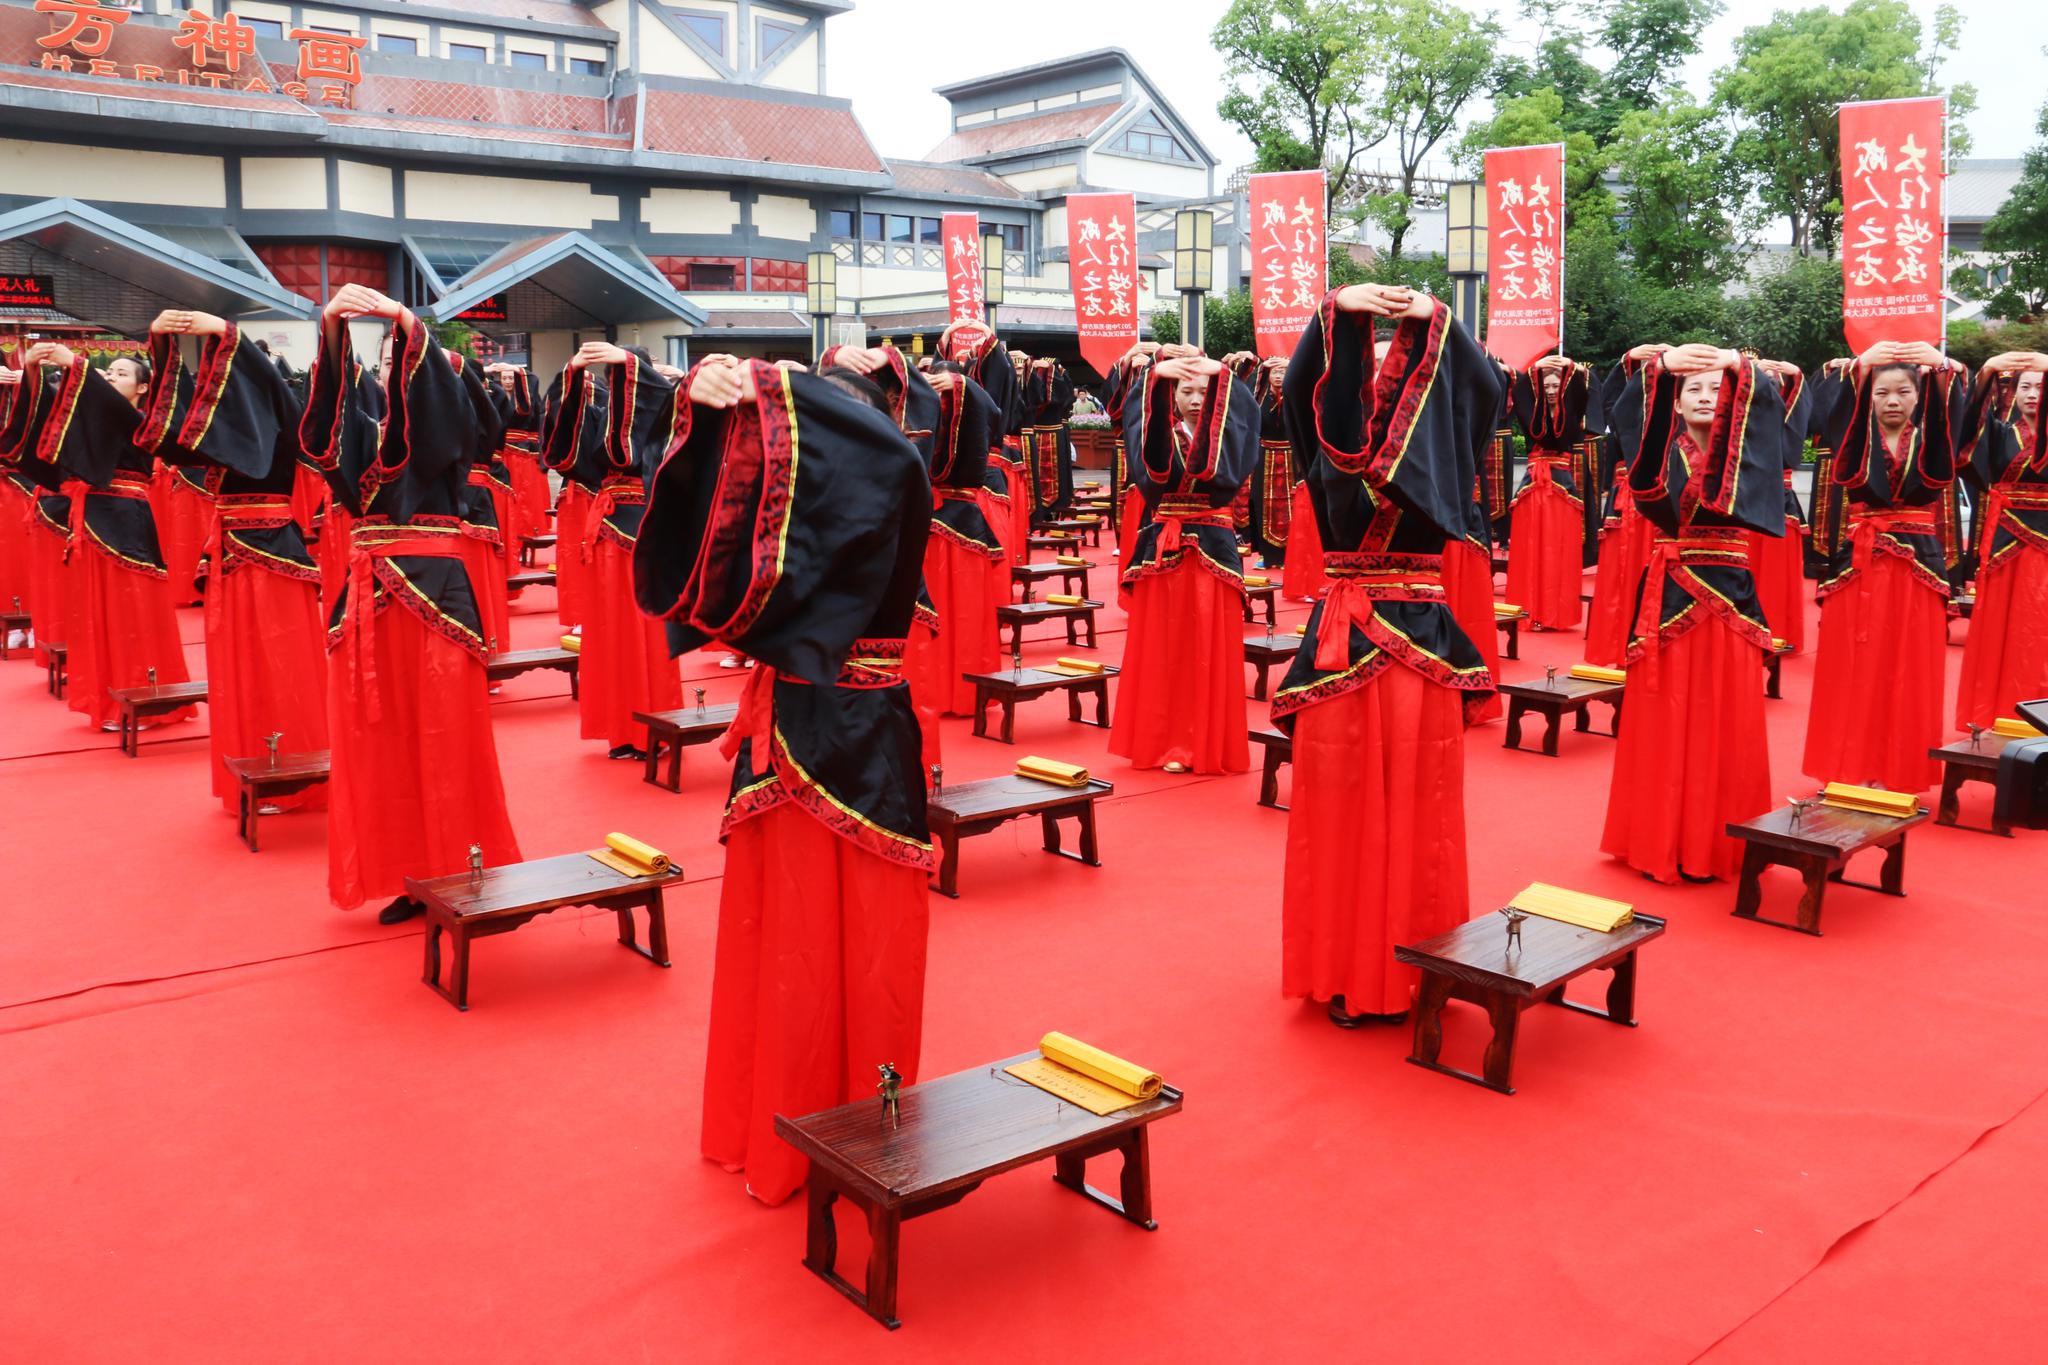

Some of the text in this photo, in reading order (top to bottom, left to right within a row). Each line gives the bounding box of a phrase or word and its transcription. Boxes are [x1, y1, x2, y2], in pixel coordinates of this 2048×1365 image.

[33, 0, 369, 86] 方神画
[40, 51, 349, 103] HERITAGE
